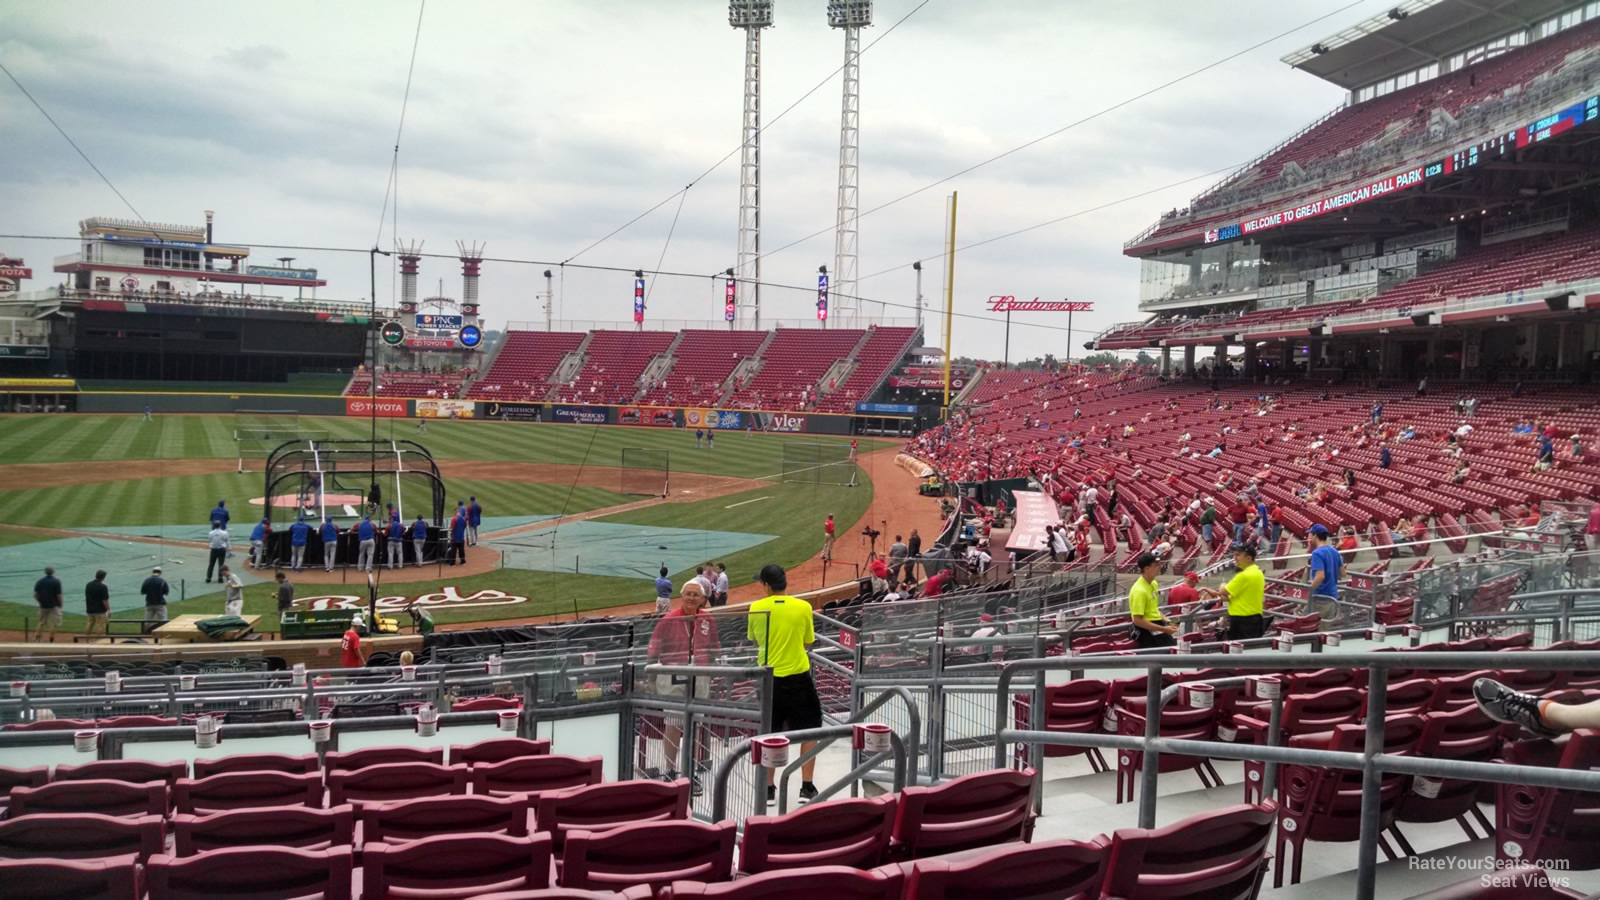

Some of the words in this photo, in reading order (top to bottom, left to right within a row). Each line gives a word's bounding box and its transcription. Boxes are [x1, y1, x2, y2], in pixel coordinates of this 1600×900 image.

[1244, 213, 1282, 233] WELCOME
[1282, 210, 1294, 223] TO
[1295, 201, 1321, 219] GREAT
[1322, 186, 1371, 212] AMERICAN
[1371, 178, 1395, 197] BALL
[1396, 168, 1422, 188] PARK
[988, 295, 1093, 312] Budweiser
[433, 316, 455, 325] PNC
[365, 402, 403, 412] TOYOTA
[556, 409, 576, 417] GREAT
[575, 411, 605, 419] AMERICAN
[1358, 578, 1366, 588] 24
[1293, 588, 1302, 596] 23
[291, 586, 532, 615] Reds
[844, 632, 851, 646] 23
